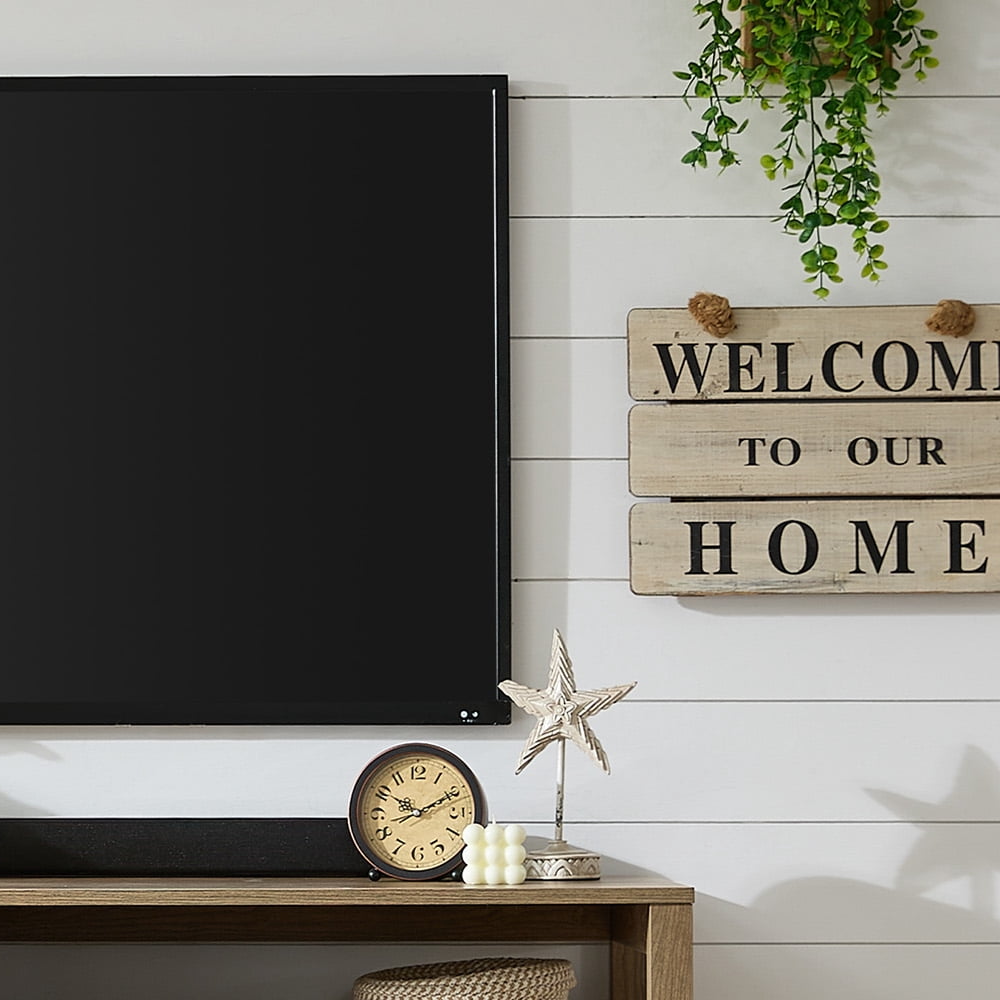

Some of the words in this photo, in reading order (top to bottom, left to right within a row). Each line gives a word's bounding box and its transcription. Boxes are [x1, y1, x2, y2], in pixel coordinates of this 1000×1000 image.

[652, 340, 1000, 395] WELCOM
[738, 437, 801, 466] TO
[847, 436, 947, 466] OUR
[683, 519, 989, 576] HOME
[410, 765, 426, 780] 12
[433, 772, 443, 785] 1
[375, 785, 391, 801] 10
[370, 807, 386, 820] 9
[375, 826, 392, 841] 8
[391, 838, 406, 855] 7
[411, 845, 424, 861] 6
[429, 839, 445, 856] 5
